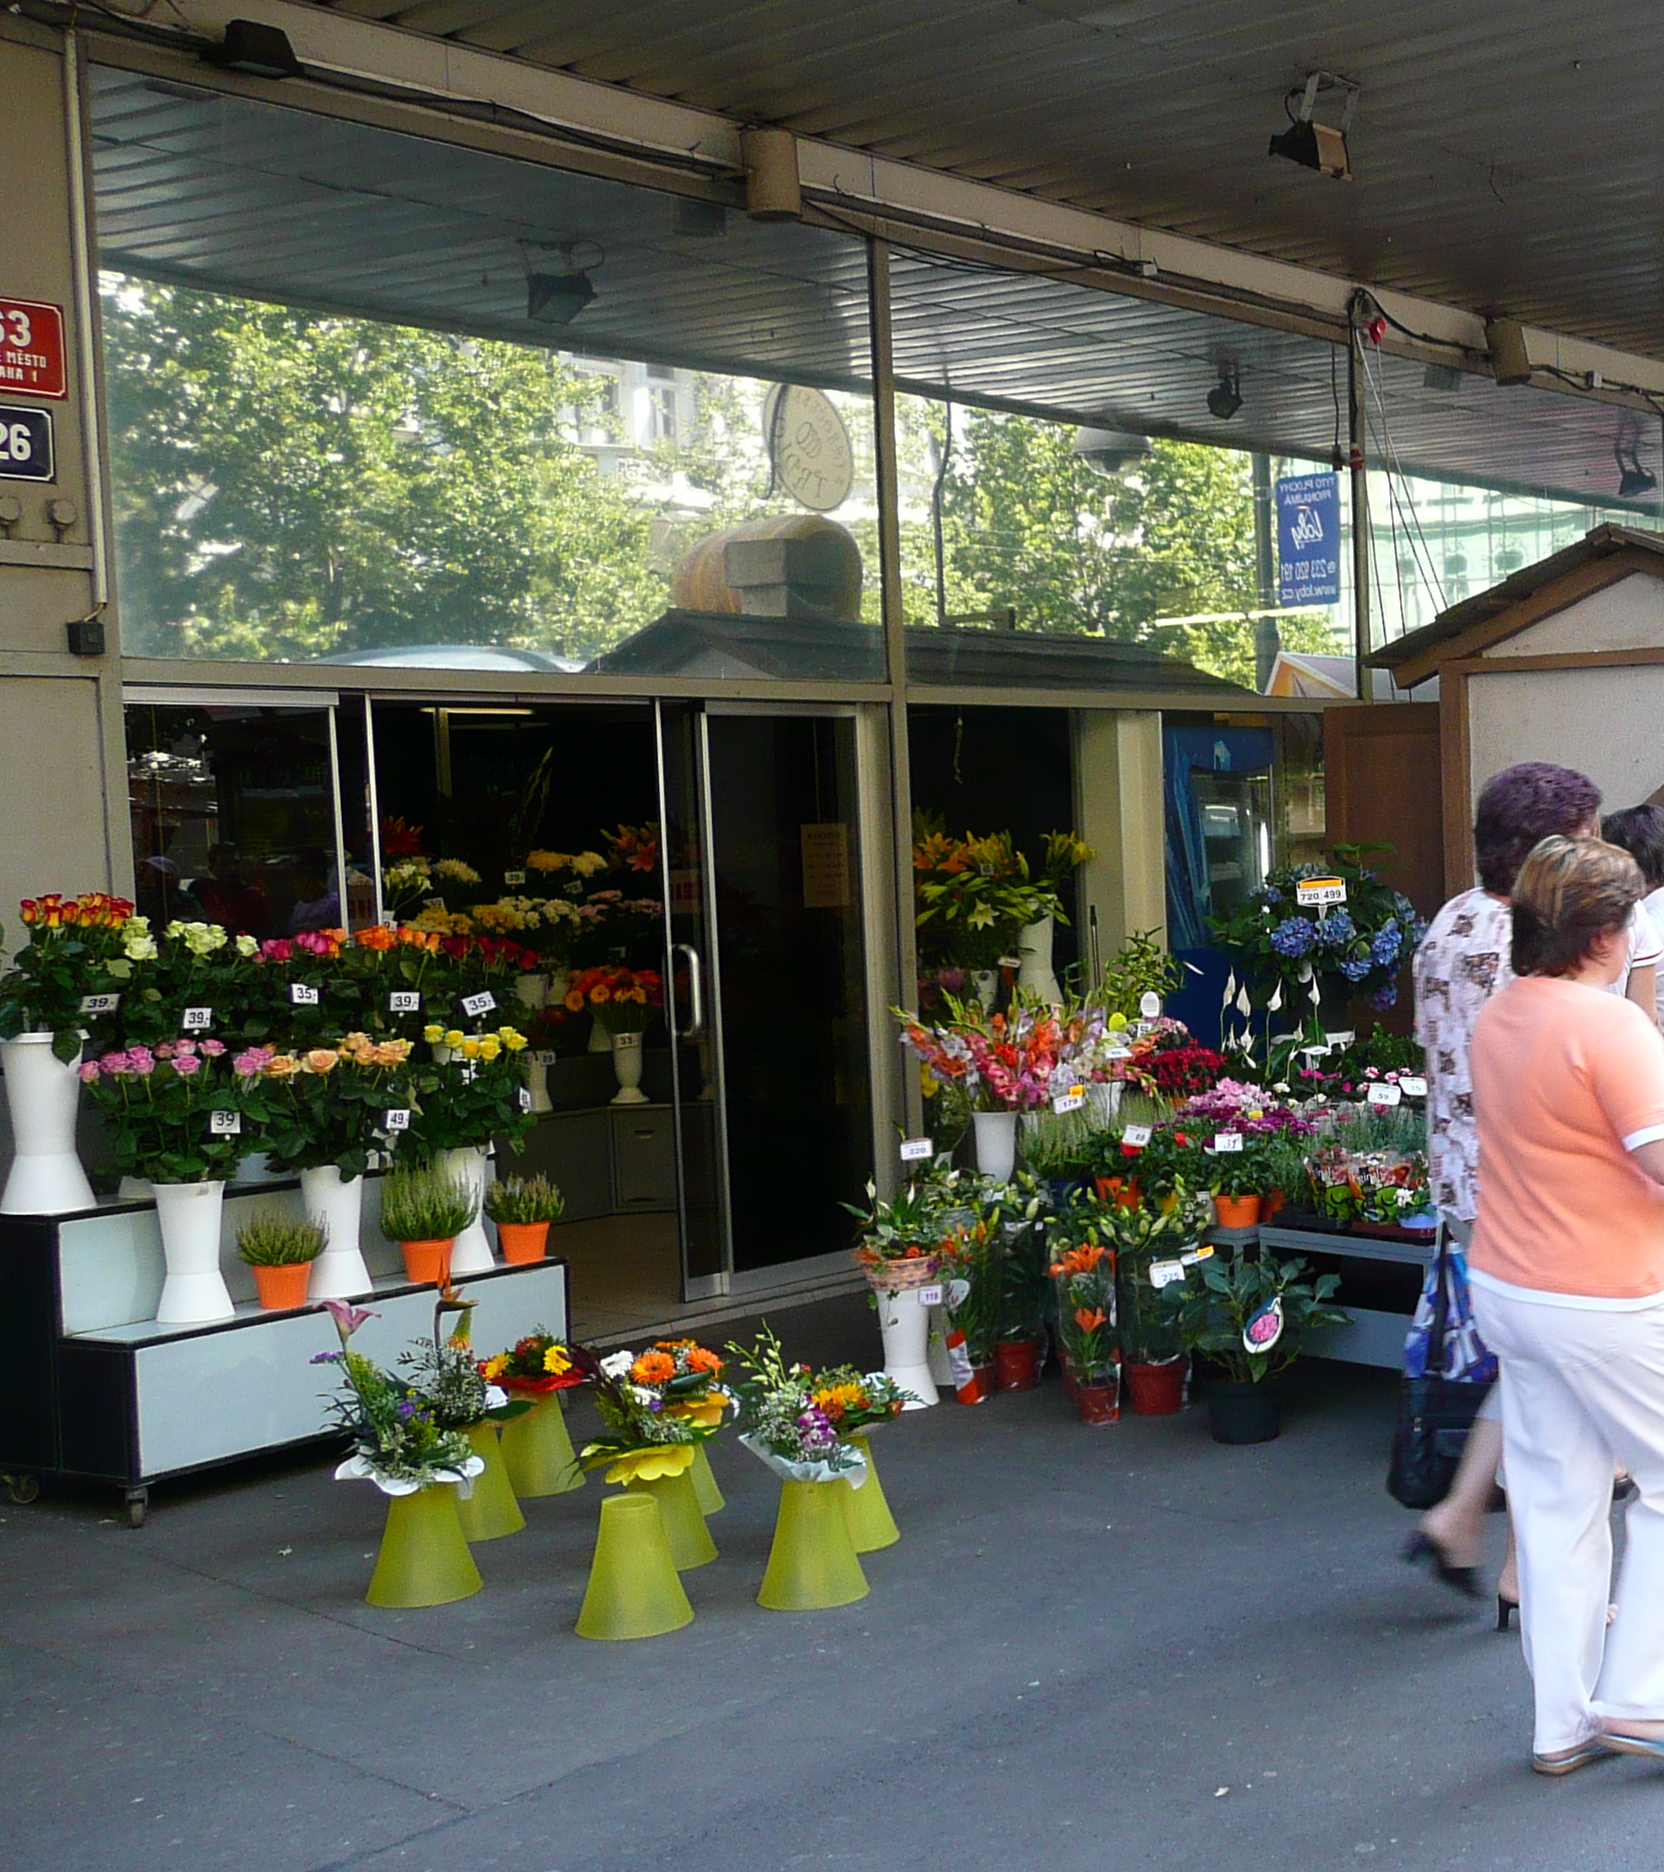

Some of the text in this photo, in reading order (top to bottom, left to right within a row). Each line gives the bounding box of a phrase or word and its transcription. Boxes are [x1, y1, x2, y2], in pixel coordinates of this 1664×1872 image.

[0, 309, 31, 347] 3
[6, 348, 47, 368] MĚSTO
[1323, 889, 1342, 900] 499
[215, 1112, 235, 1127] 39
